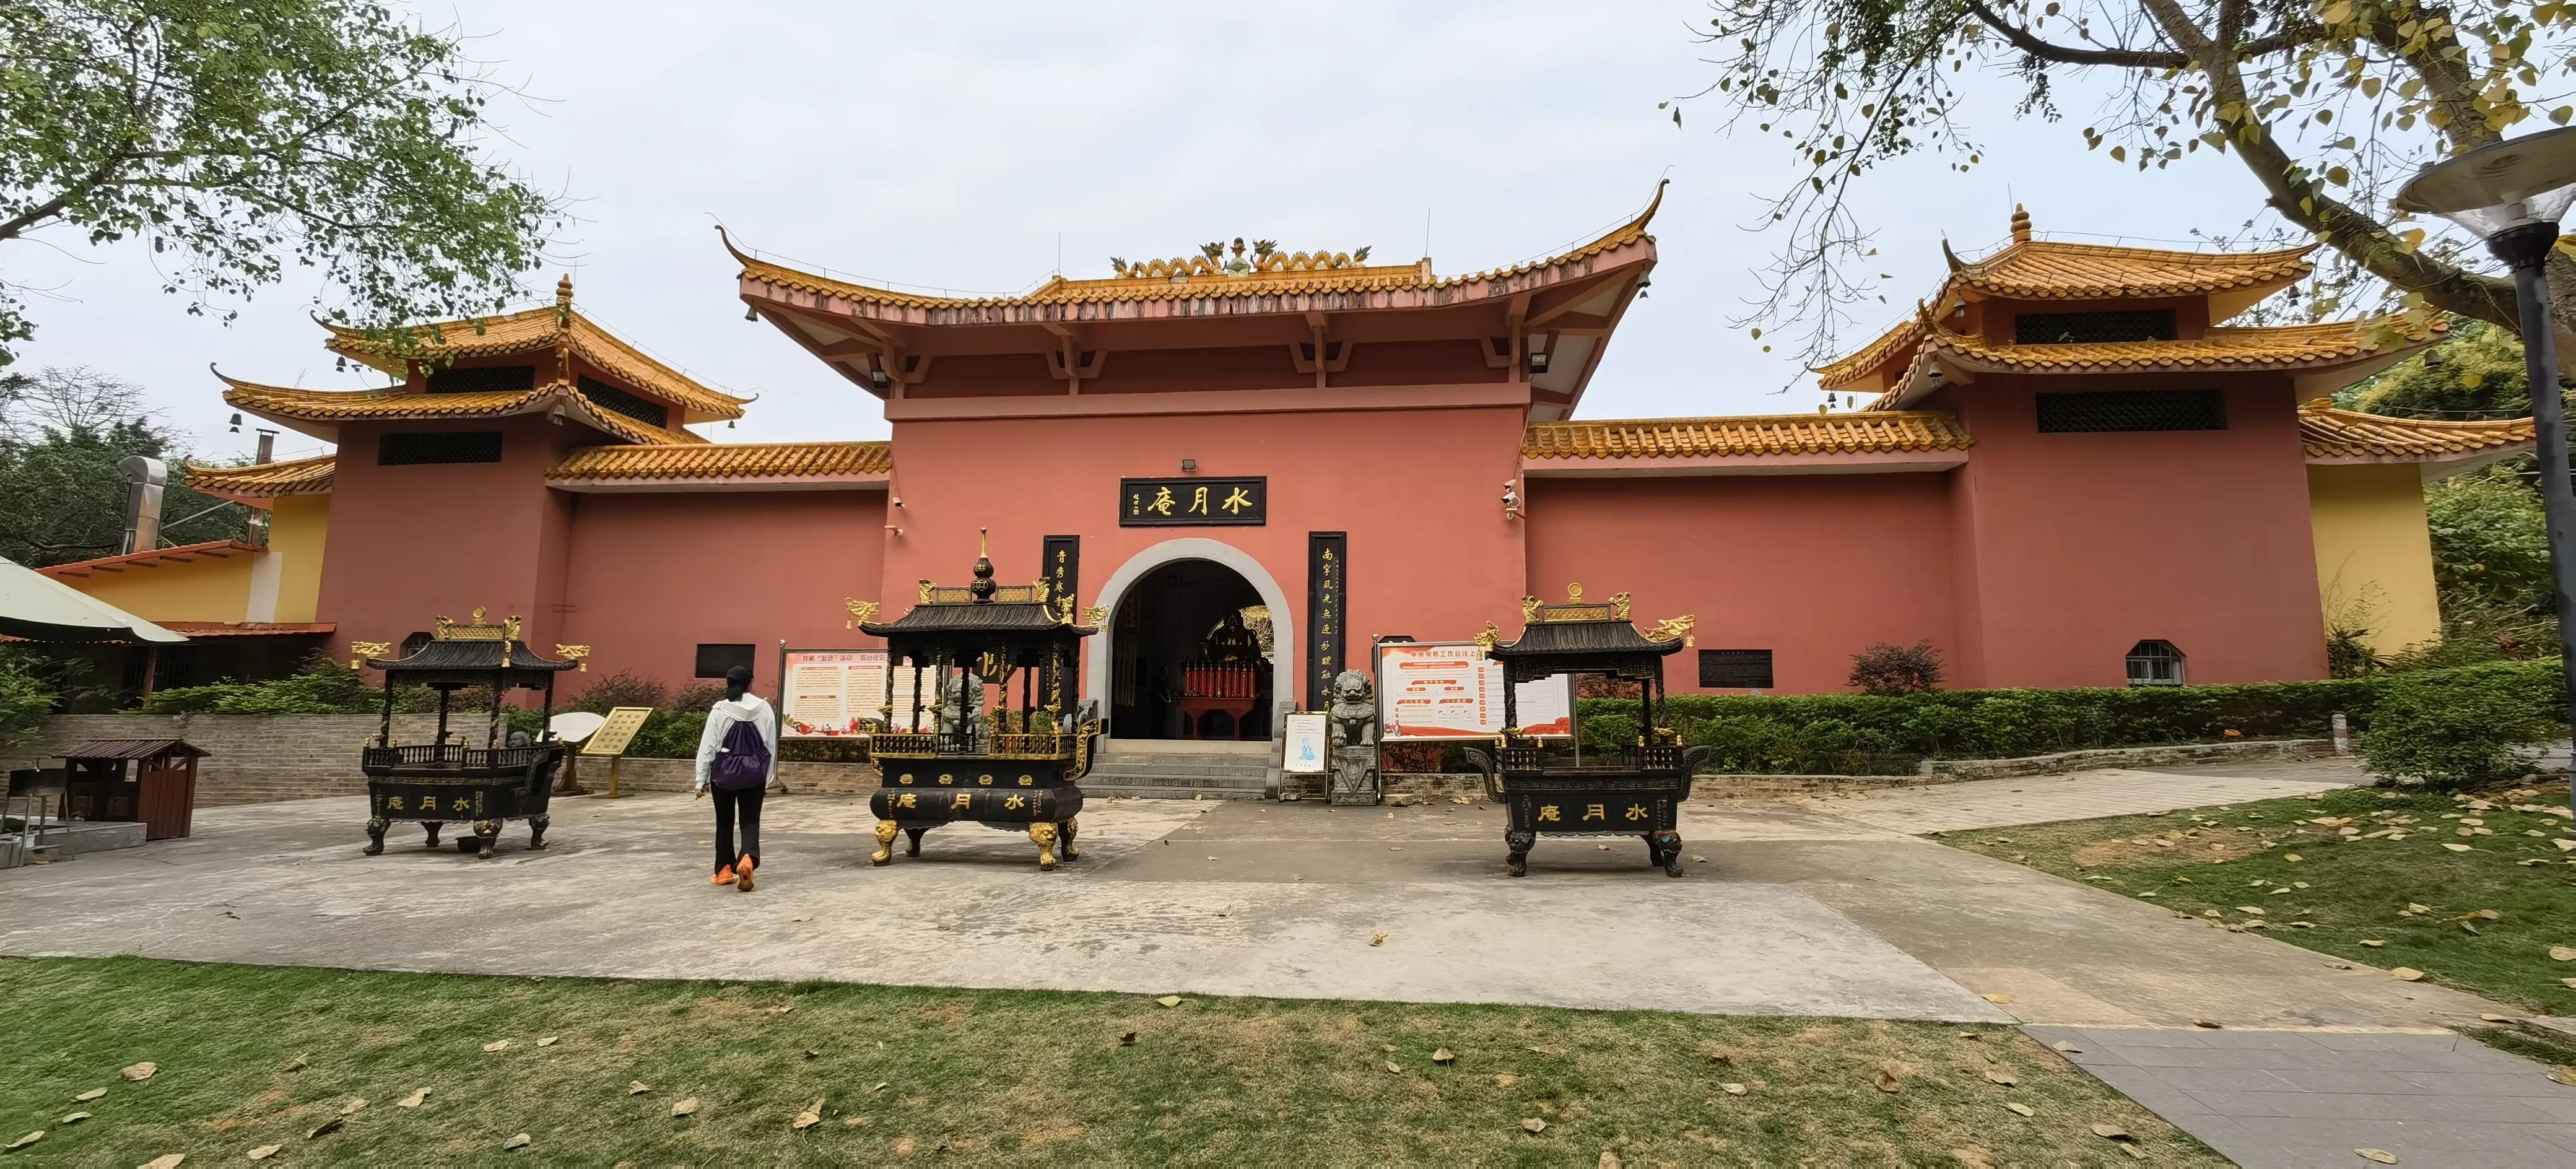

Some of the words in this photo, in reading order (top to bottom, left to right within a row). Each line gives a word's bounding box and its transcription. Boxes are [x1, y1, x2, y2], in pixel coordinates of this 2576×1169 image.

[1147, 487, 1253, 515] 水月庵
[387, 796, 471, 811] 水月庵
[897, 793, 1025, 810] 水月庵
[1538, 803, 1648, 822] 水月庵
